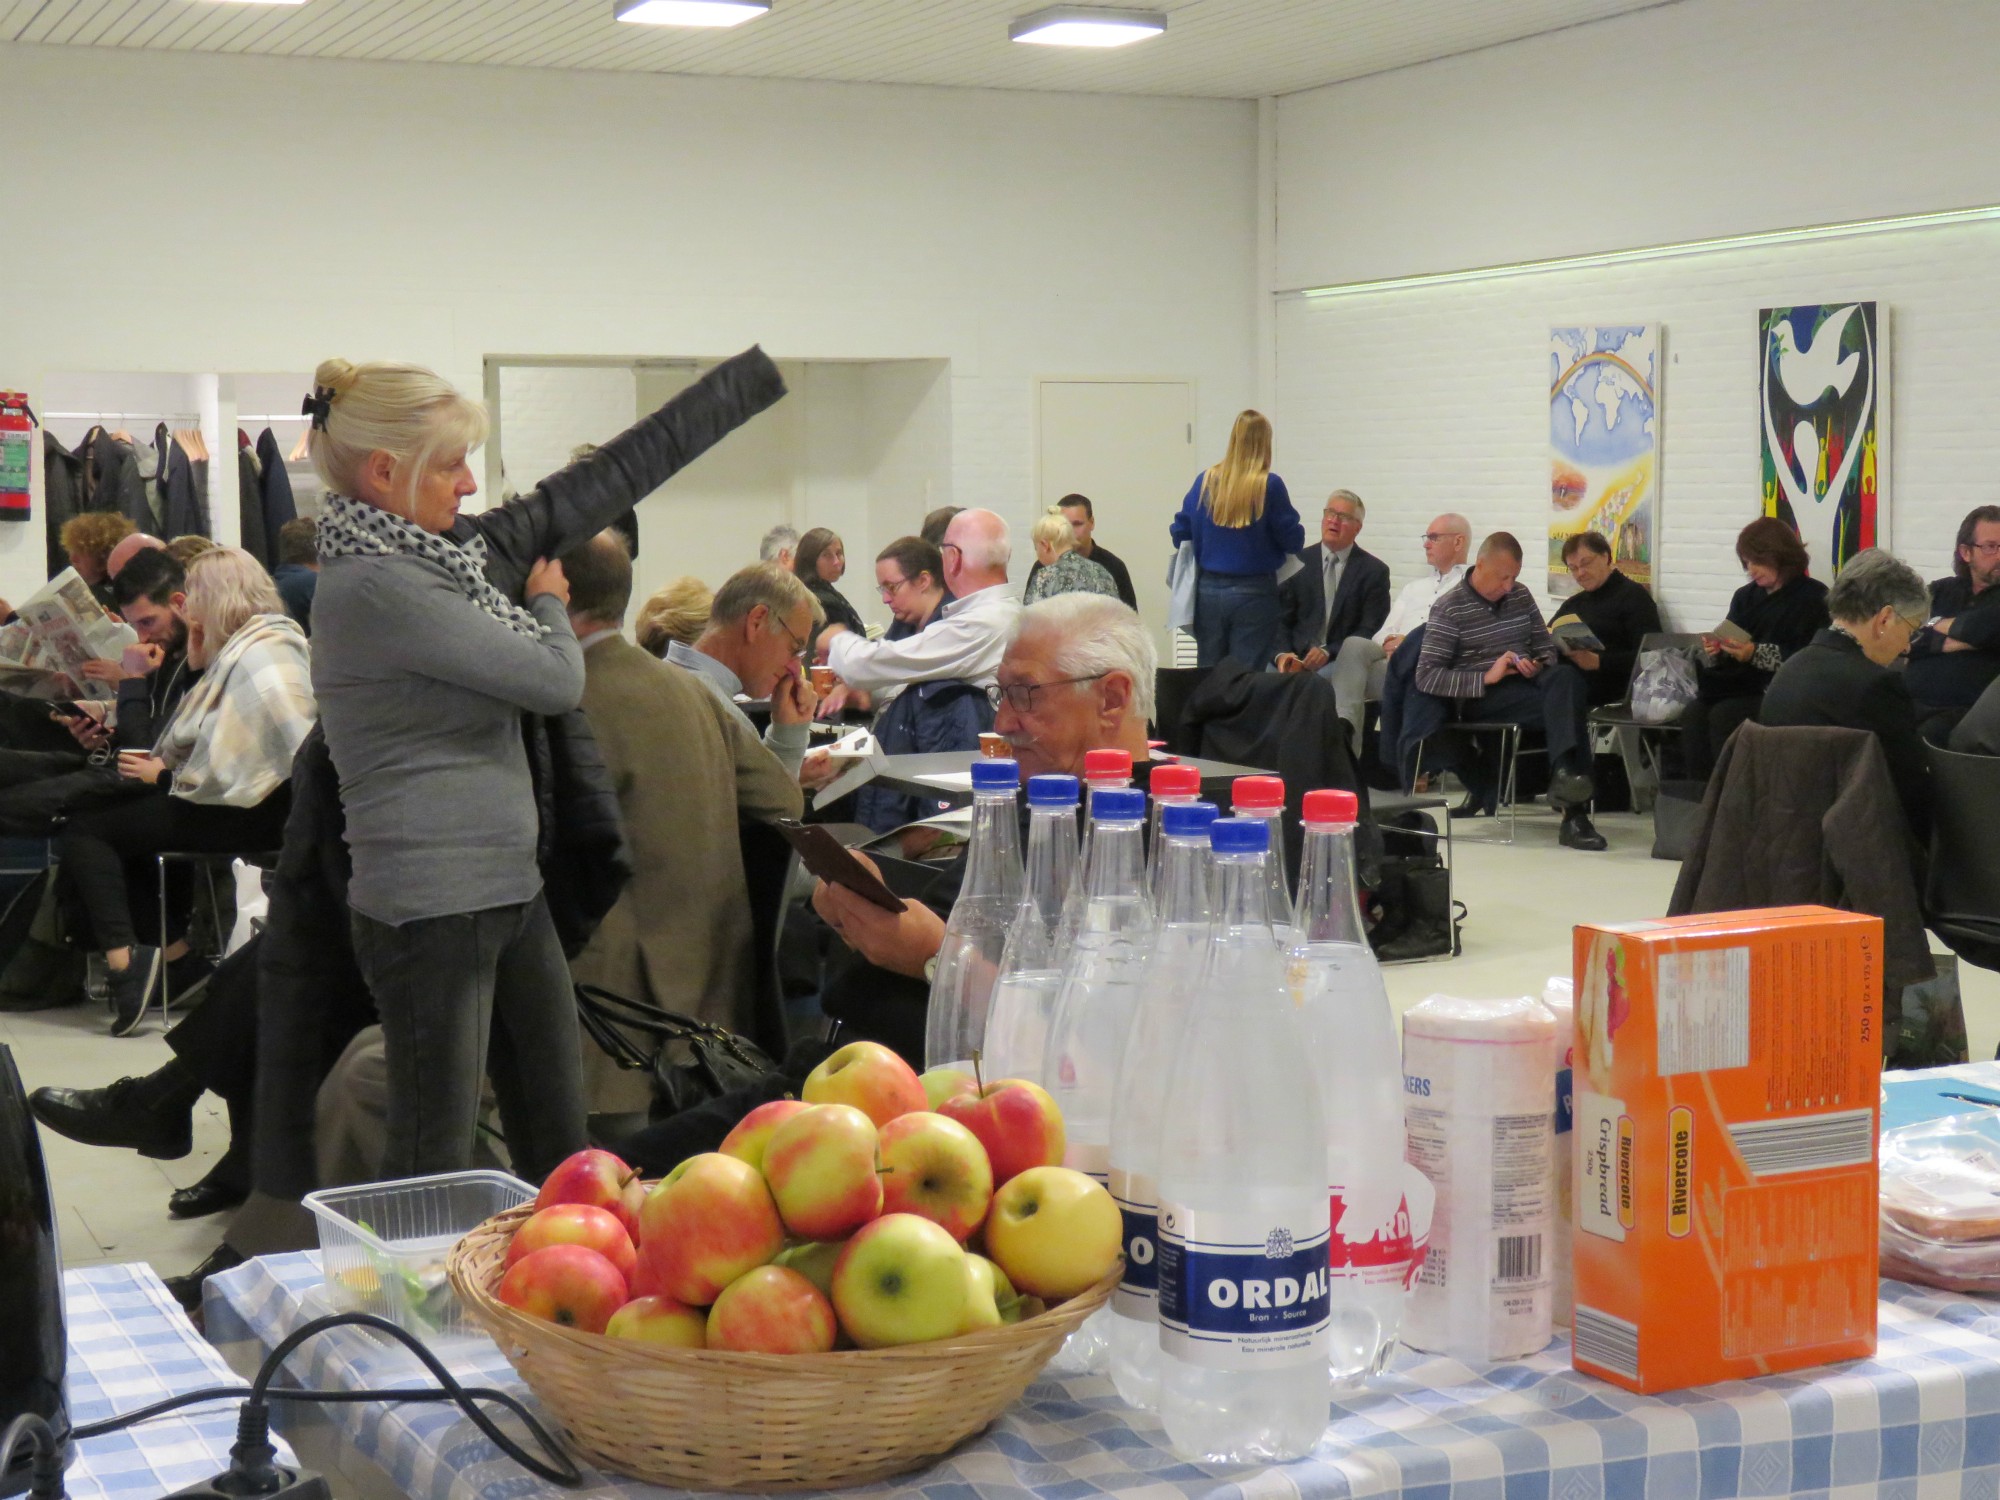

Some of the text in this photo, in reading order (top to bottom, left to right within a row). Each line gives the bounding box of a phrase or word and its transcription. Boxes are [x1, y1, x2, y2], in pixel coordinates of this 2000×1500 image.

[1863, 1005, 1873, 1014] g
[1861, 1018, 1870, 1043] 250
[1587, 1149, 1595, 1176] 250g
[1597, 1118, 1612, 1216] Crispbread
[1620, 1136, 1632, 1209] Rivercote
[1672, 1130, 1689, 1216] Rivercote
[1207, 1266, 1328, 1309] ORDAL
[1249, 1308, 1307, 1322] Bron Source
